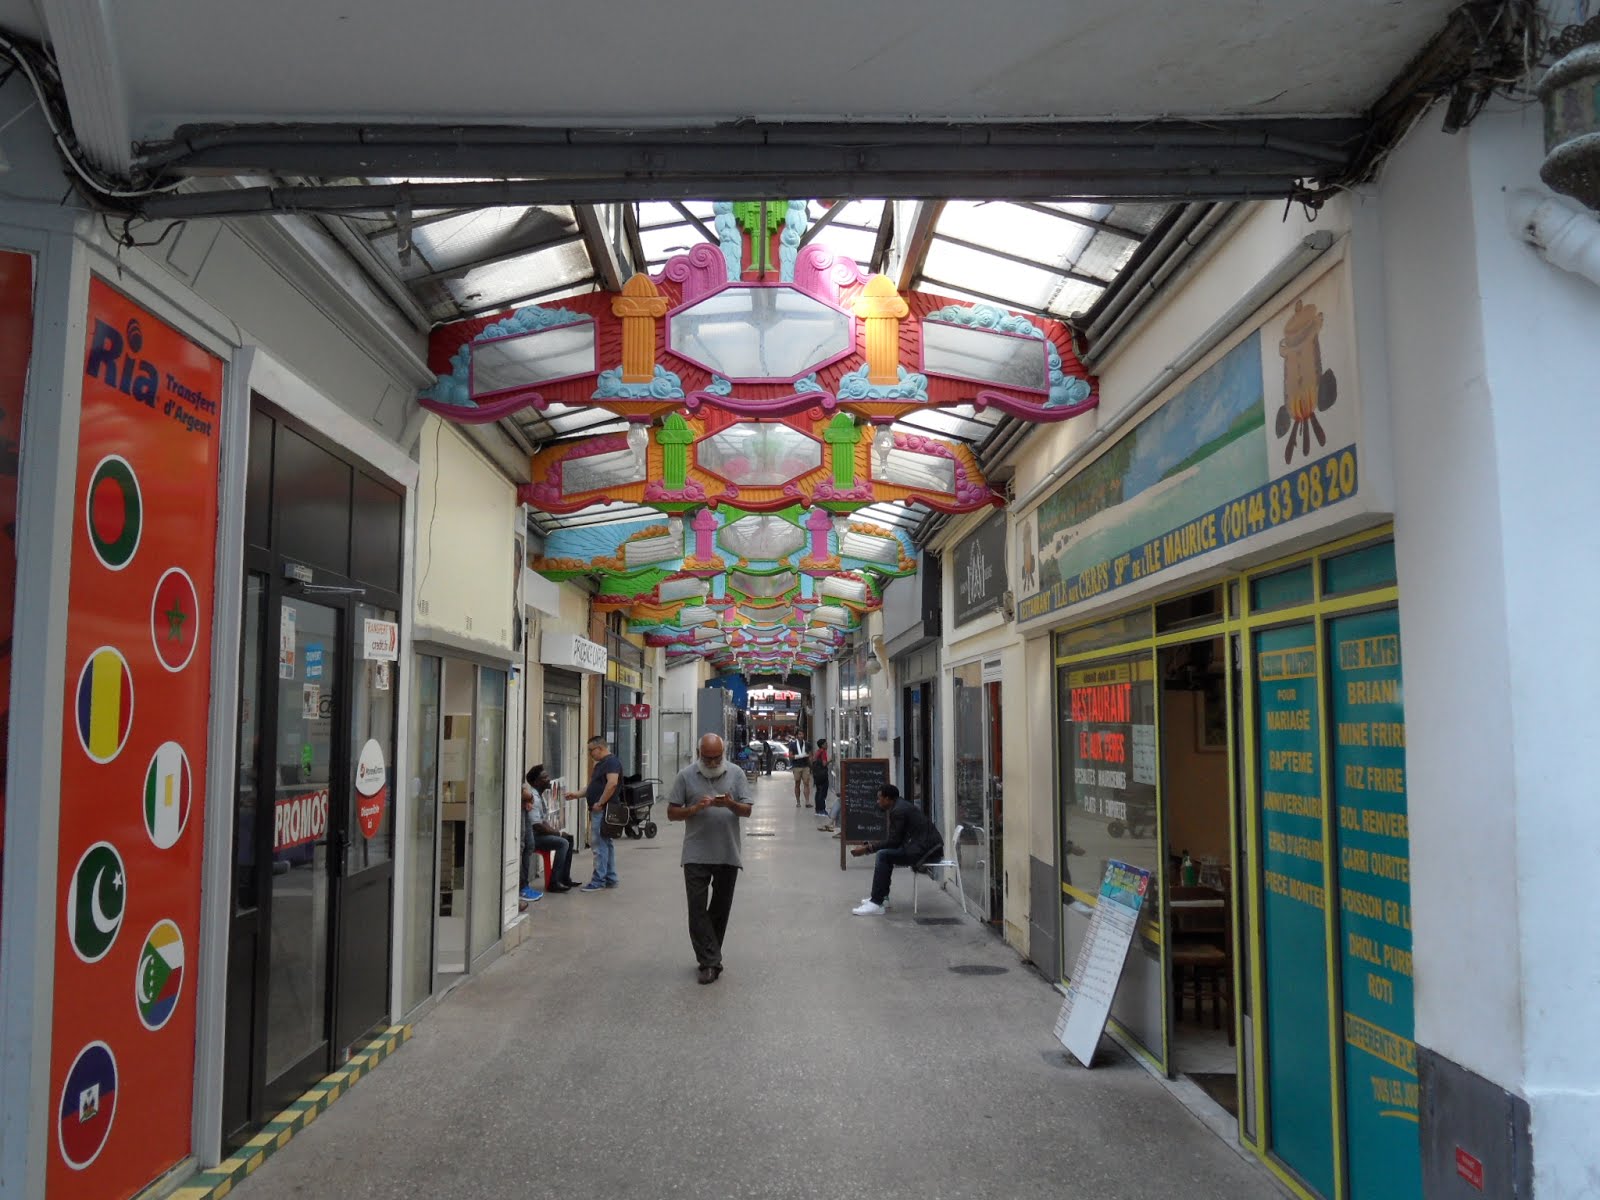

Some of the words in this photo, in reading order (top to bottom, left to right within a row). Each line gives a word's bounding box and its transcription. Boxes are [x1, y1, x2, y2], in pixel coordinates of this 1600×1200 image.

[87, 318, 159, 409] Ria
[167, 373, 216, 415] Transfert
[164, 399, 211, 436] d'Argent
[1020, 589, 1051, 621] RESTAURANT
[1163, 513, 1216, 566] MAURICE
[1071, 682, 1131, 723] RESTAURANT
[1277, 689, 1297, 701] POUR
[1266, 709, 1311, 731] MARIAGE
[1338, 722, 1369, 746] MINE
[1104, 733, 1125, 763] CERFS
[1269, 750, 1314, 774] BAPTEME
[1345, 765, 1365, 790] RIZ
[1367, 767, 1404, 793] FRIRE
[274, 794, 328, 848] PROMOS
[1340, 806, 1361, 831] BOL
[1342, 847, 1369, 874] CARRI
[1341, 887, 1383, 921] POISSON
[1367, 973, 1394, 1005] ROTI
